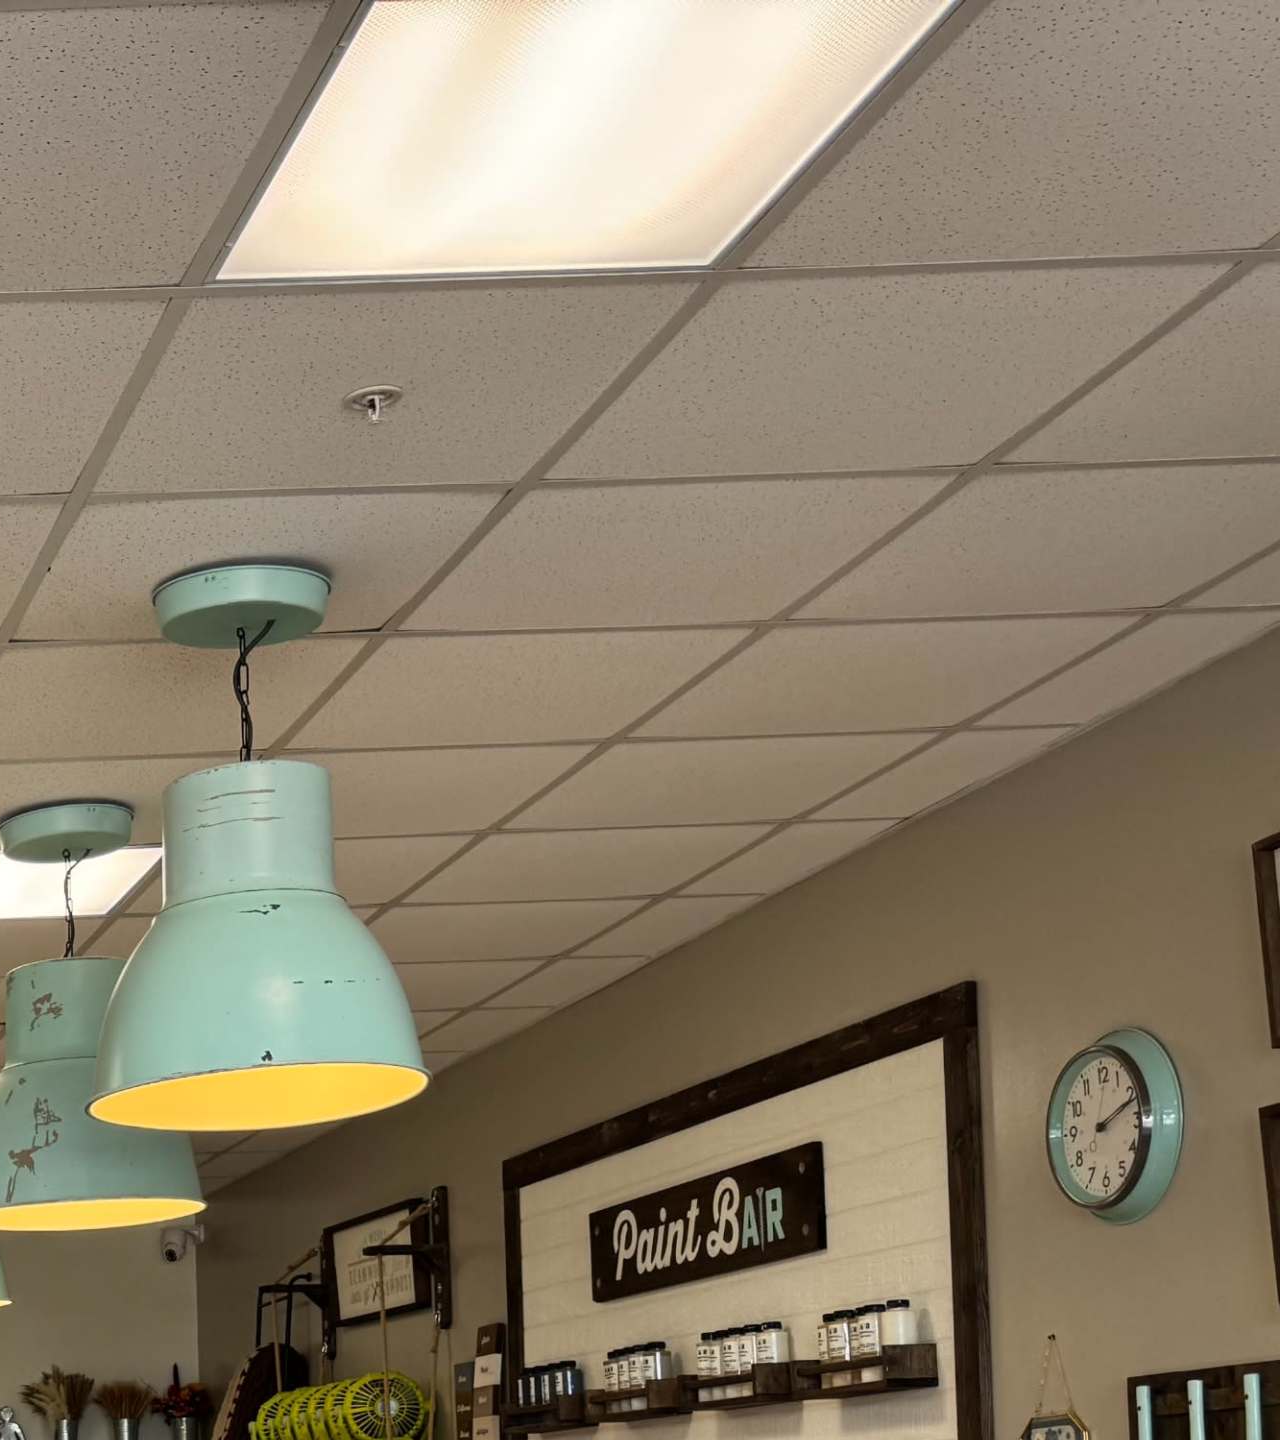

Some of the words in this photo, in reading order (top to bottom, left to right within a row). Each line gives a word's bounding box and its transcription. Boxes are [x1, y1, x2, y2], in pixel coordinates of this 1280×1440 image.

[1097, 1066, 1110, 1085] 12
[1082, 1076, 1090, 1096] 11
[1071, 1100, 1083, 1119] 10
[1069, 1125, 1078, 1143] 9
[1075, 1150, 1084, 1167] 8
[1088, 1166, 1096, 1185] 7
[1118, 1160, 1127, 1178] 5
[1102, 1170, 1111, 1188] 6
[612, 1197, 702, 1281] Paint
